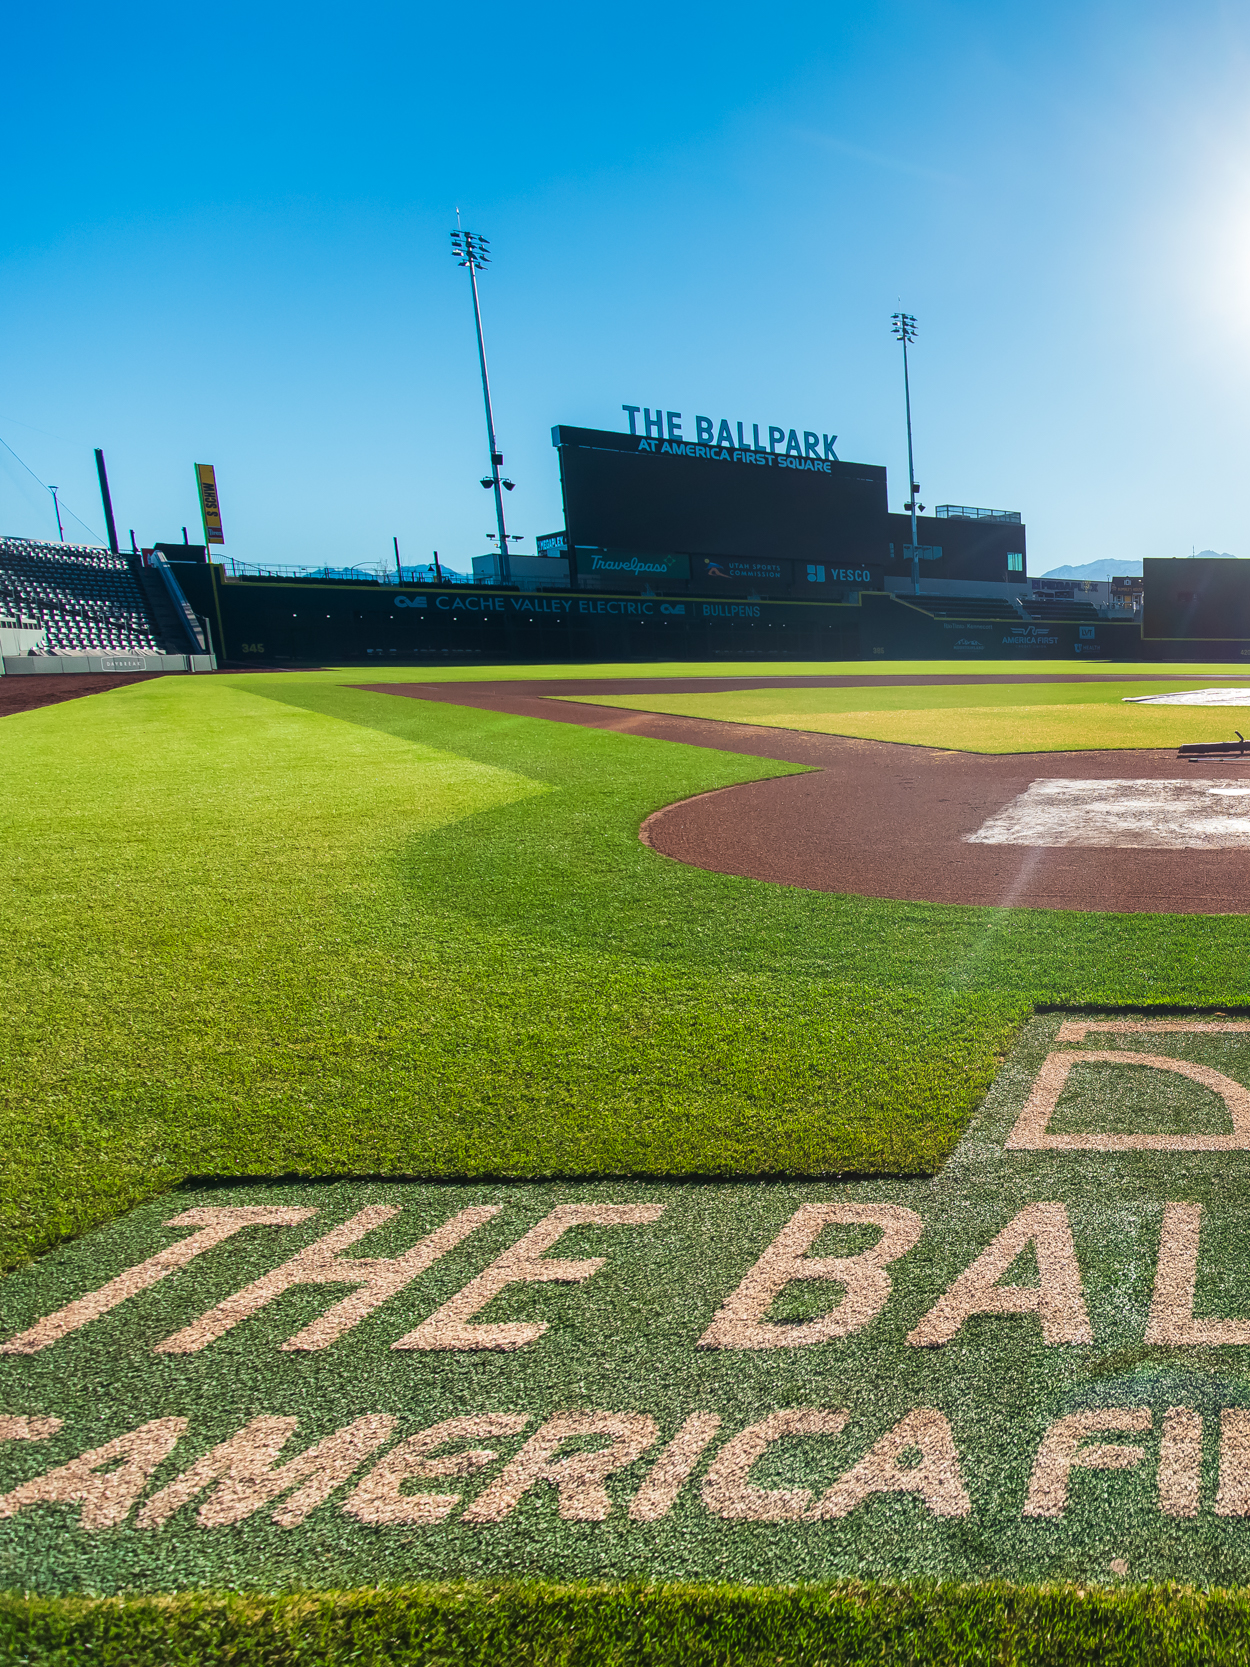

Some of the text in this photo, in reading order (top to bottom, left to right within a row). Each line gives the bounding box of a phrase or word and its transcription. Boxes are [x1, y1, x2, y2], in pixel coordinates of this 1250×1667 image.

[622, 405, 839, 461] THE BALLPARK
[638, 439, 832, 473] AT AMERICA FIRST SQUARE
[591, 555, 667, 576] Travelpass
[730, 570, 781, 578] COMMISSION
[753, 563, 781, 571] SPORTS
[831, 568, 871, 582] YESCO
[436, 596, 505, 611] CACHE
[511, 598, 572, 612] VALLEY
[579, 600, 653, 615] ELECTRIC
[703, 604, 760, 617] BULLPENS
[1002, 636, 1036, 644] AMERICA
[1081, 628, 1093, 636] LVT
[242, 643, 265, 653] 345
[0, 1203, 667, 1354] THE
[0, 1408, 973, 1529] AMERICA
